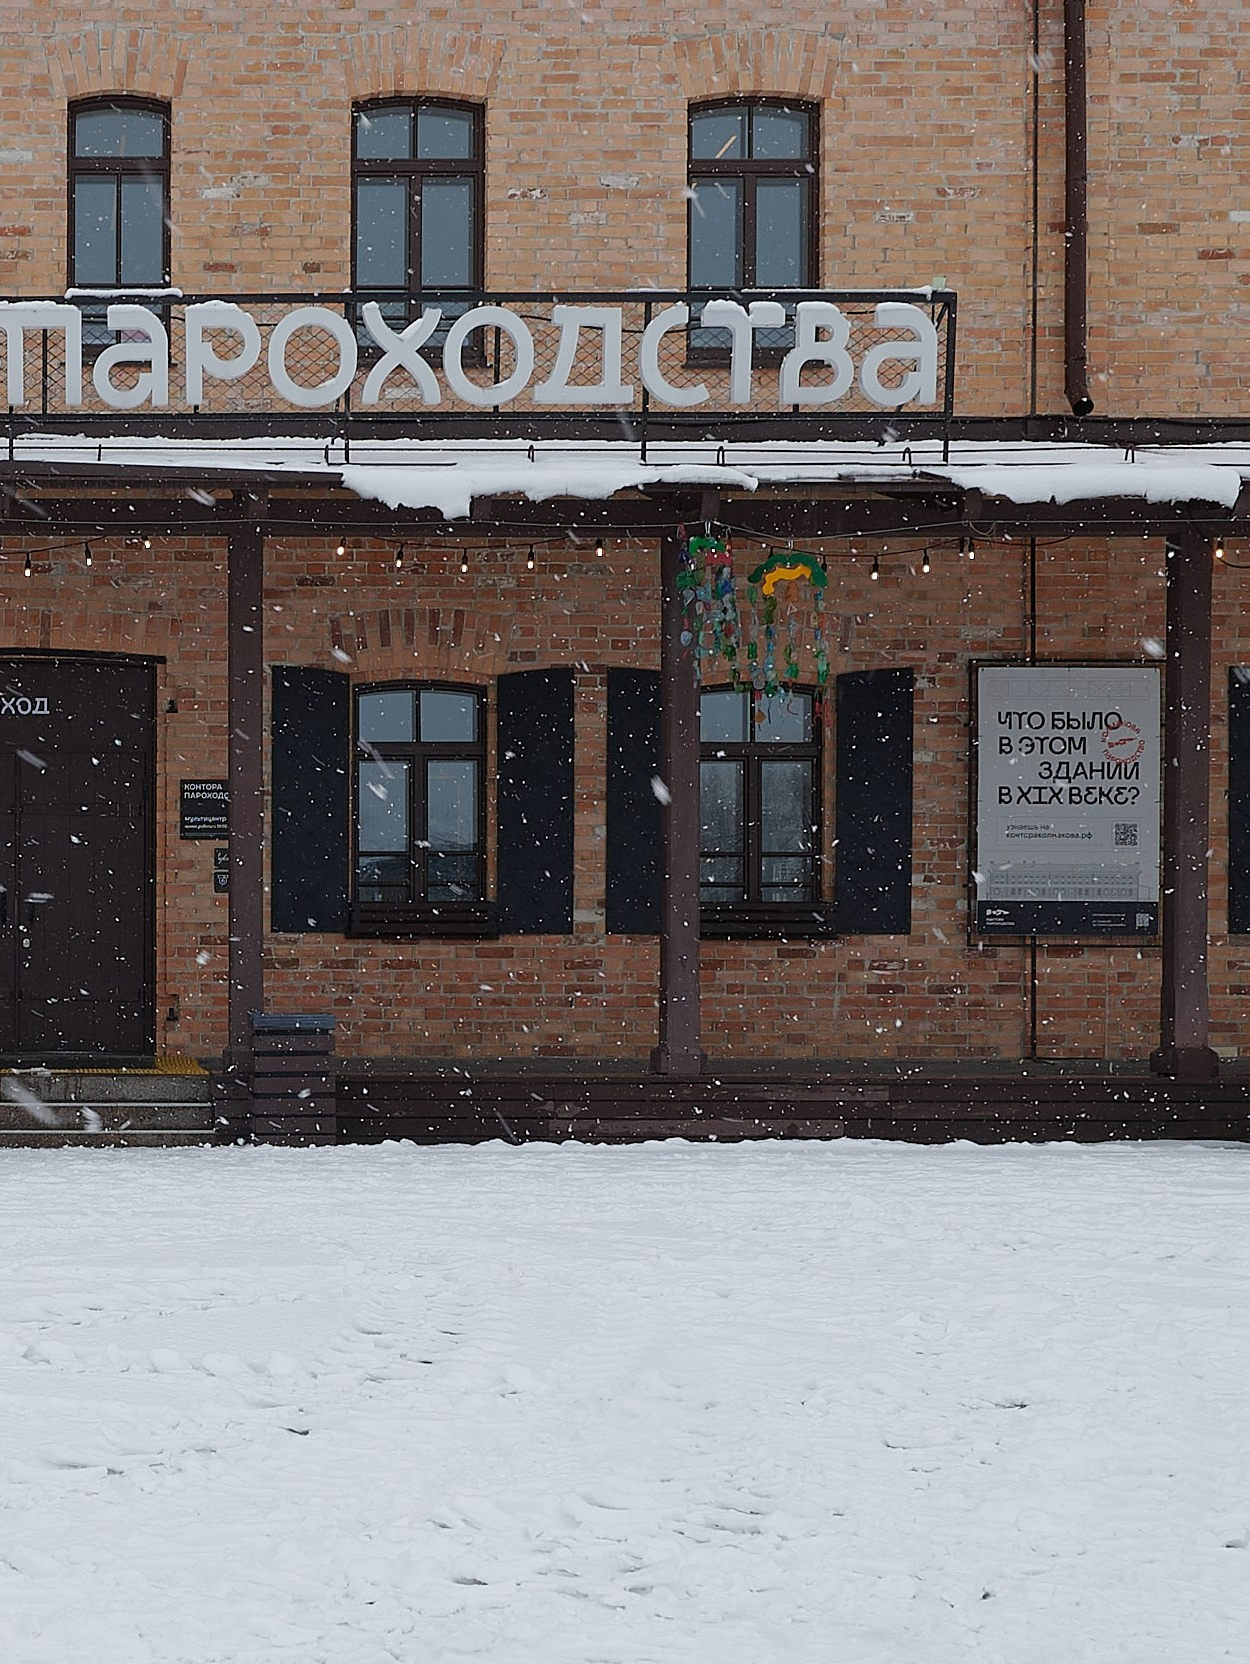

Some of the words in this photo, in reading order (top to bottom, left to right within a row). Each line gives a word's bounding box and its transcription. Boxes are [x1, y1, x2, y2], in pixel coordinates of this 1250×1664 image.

[998, 711, 1045, 730] ЧТО
[1051, 711, 1122, 730] БЫЛО
[999, 736, 1013, 755] В
[1018, 736, 1086, 755] ЭТОМ
[1038, 761, 1140, 783] ЗДАНИИ
[184, 783, 223, 791] КОНТОРА
[998, 786, 1013, 805] В
[1069, 786, 1140, 805] ВЕКЕ?
